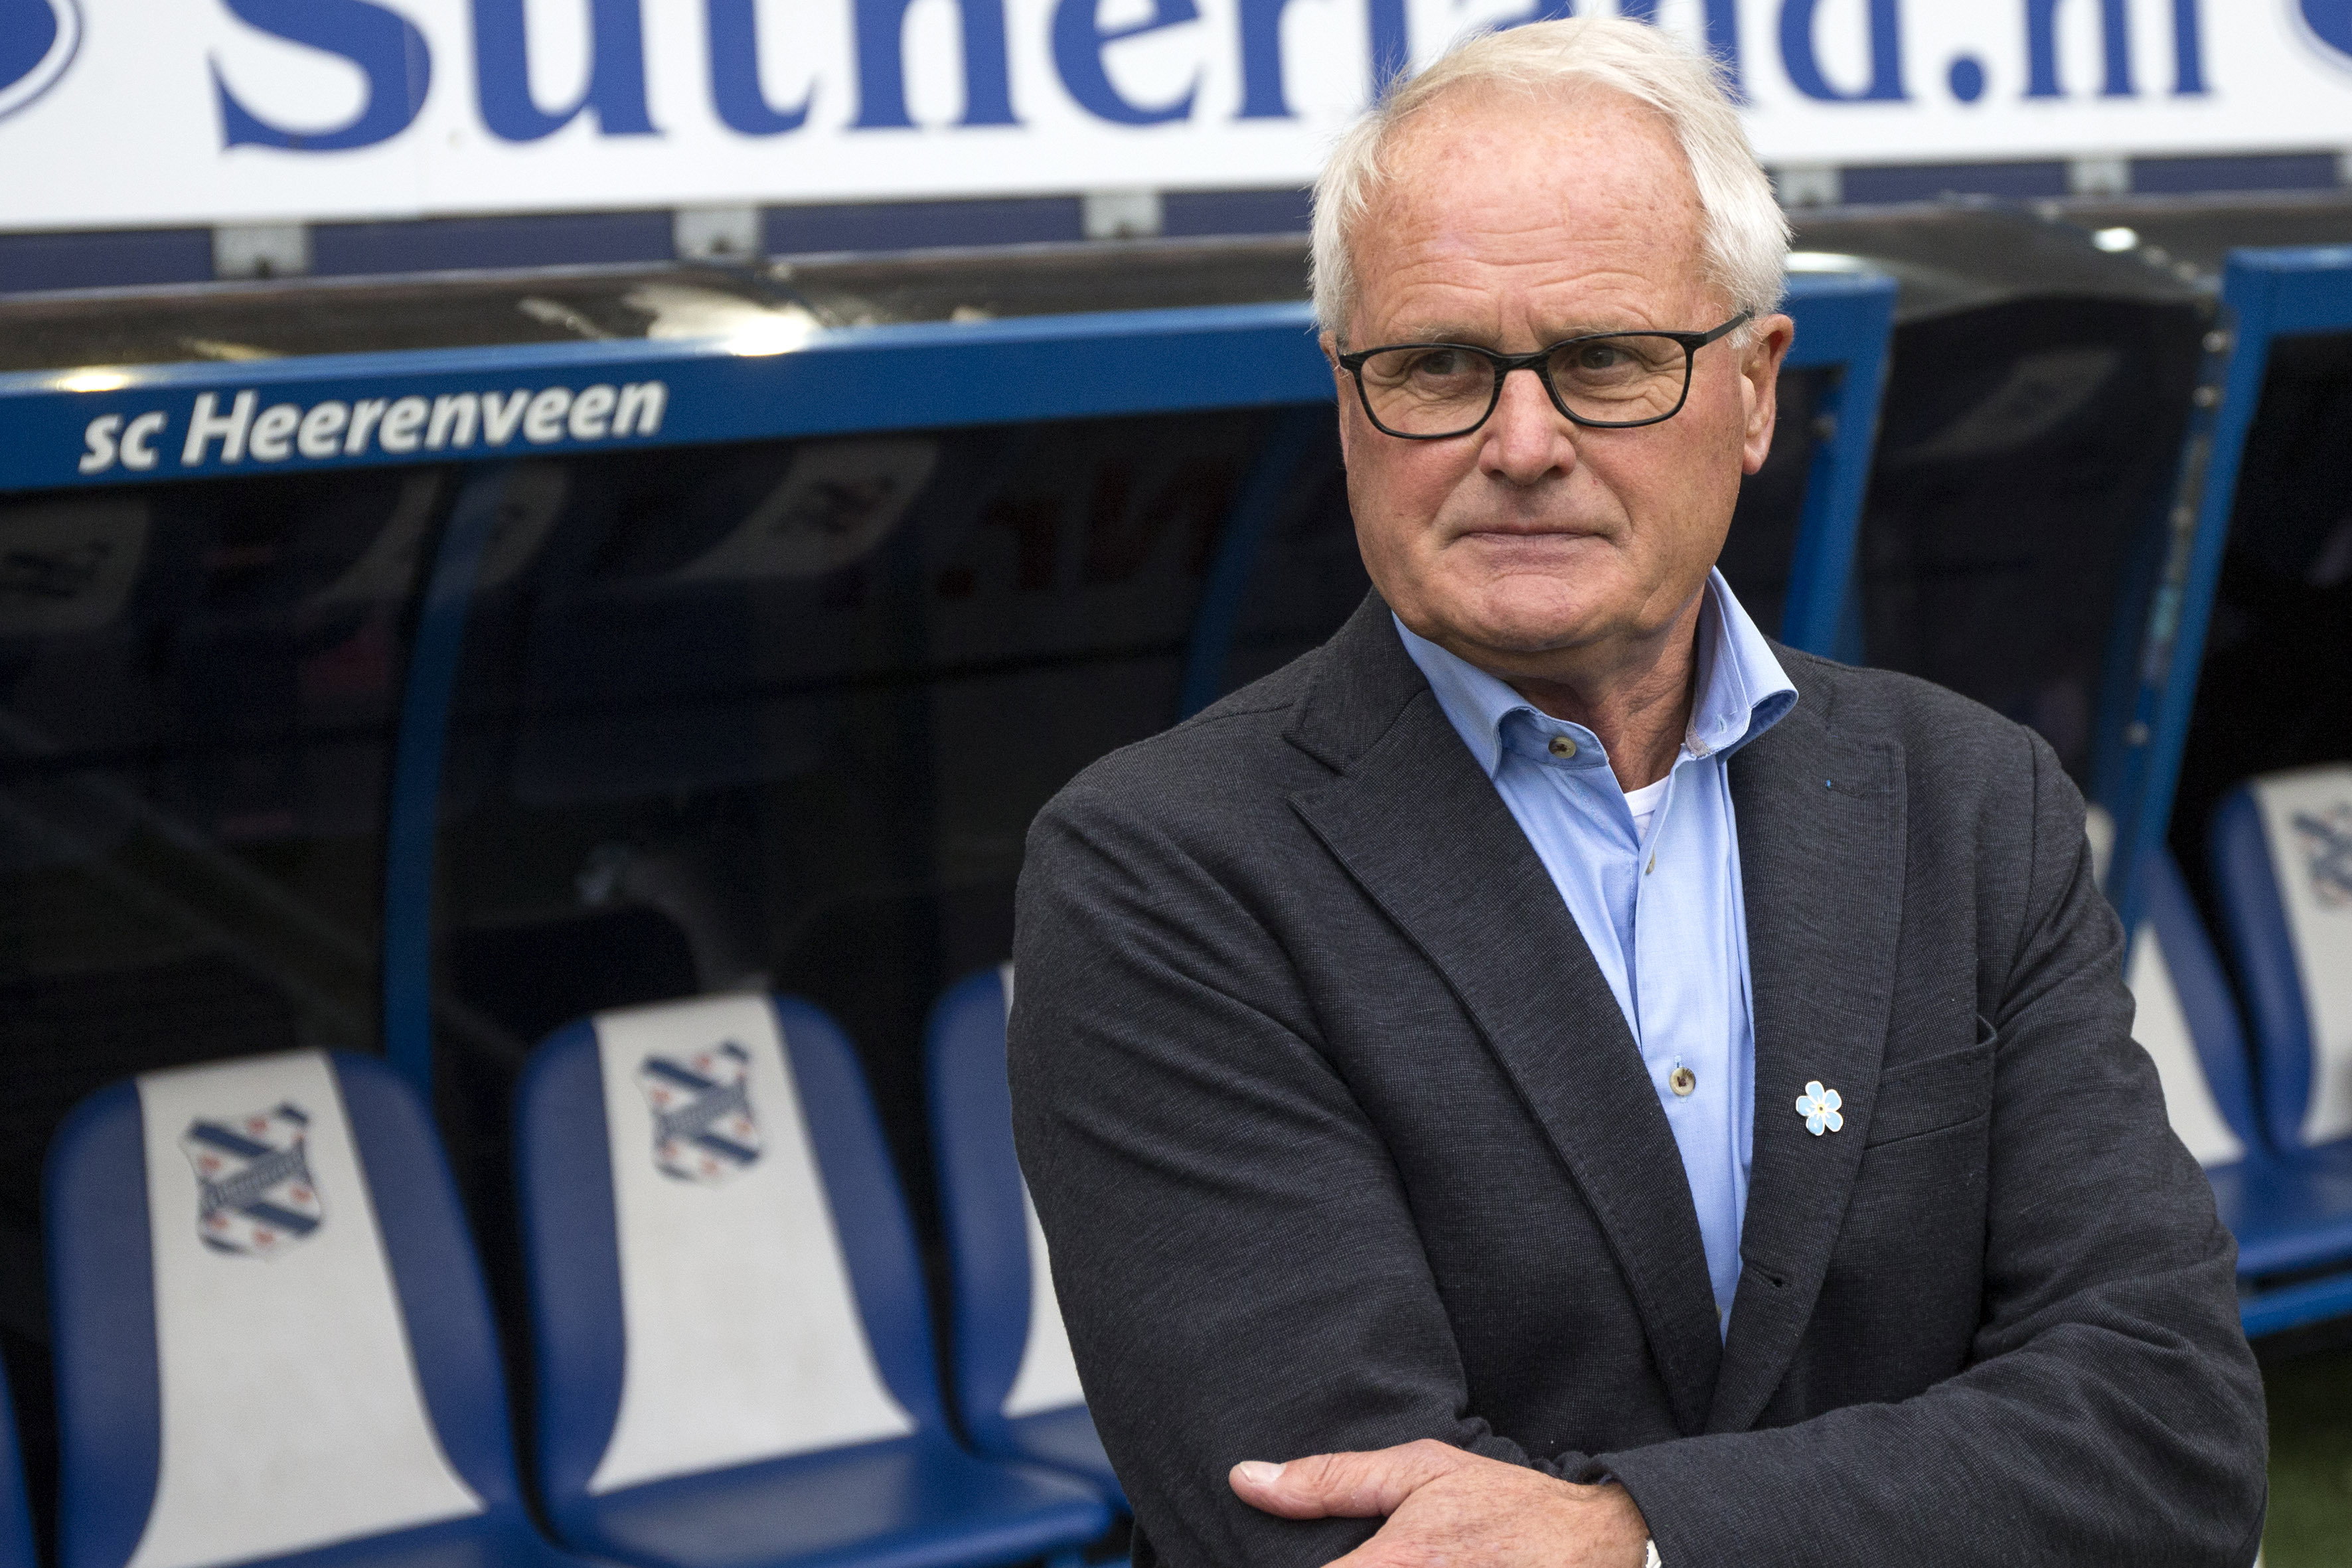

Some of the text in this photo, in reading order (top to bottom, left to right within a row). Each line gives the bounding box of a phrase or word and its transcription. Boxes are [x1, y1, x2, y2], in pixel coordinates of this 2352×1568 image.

[208, 0, 2212, 153] Sutherd.nl
[78, 380, 667, 474] sc Heerenveen
